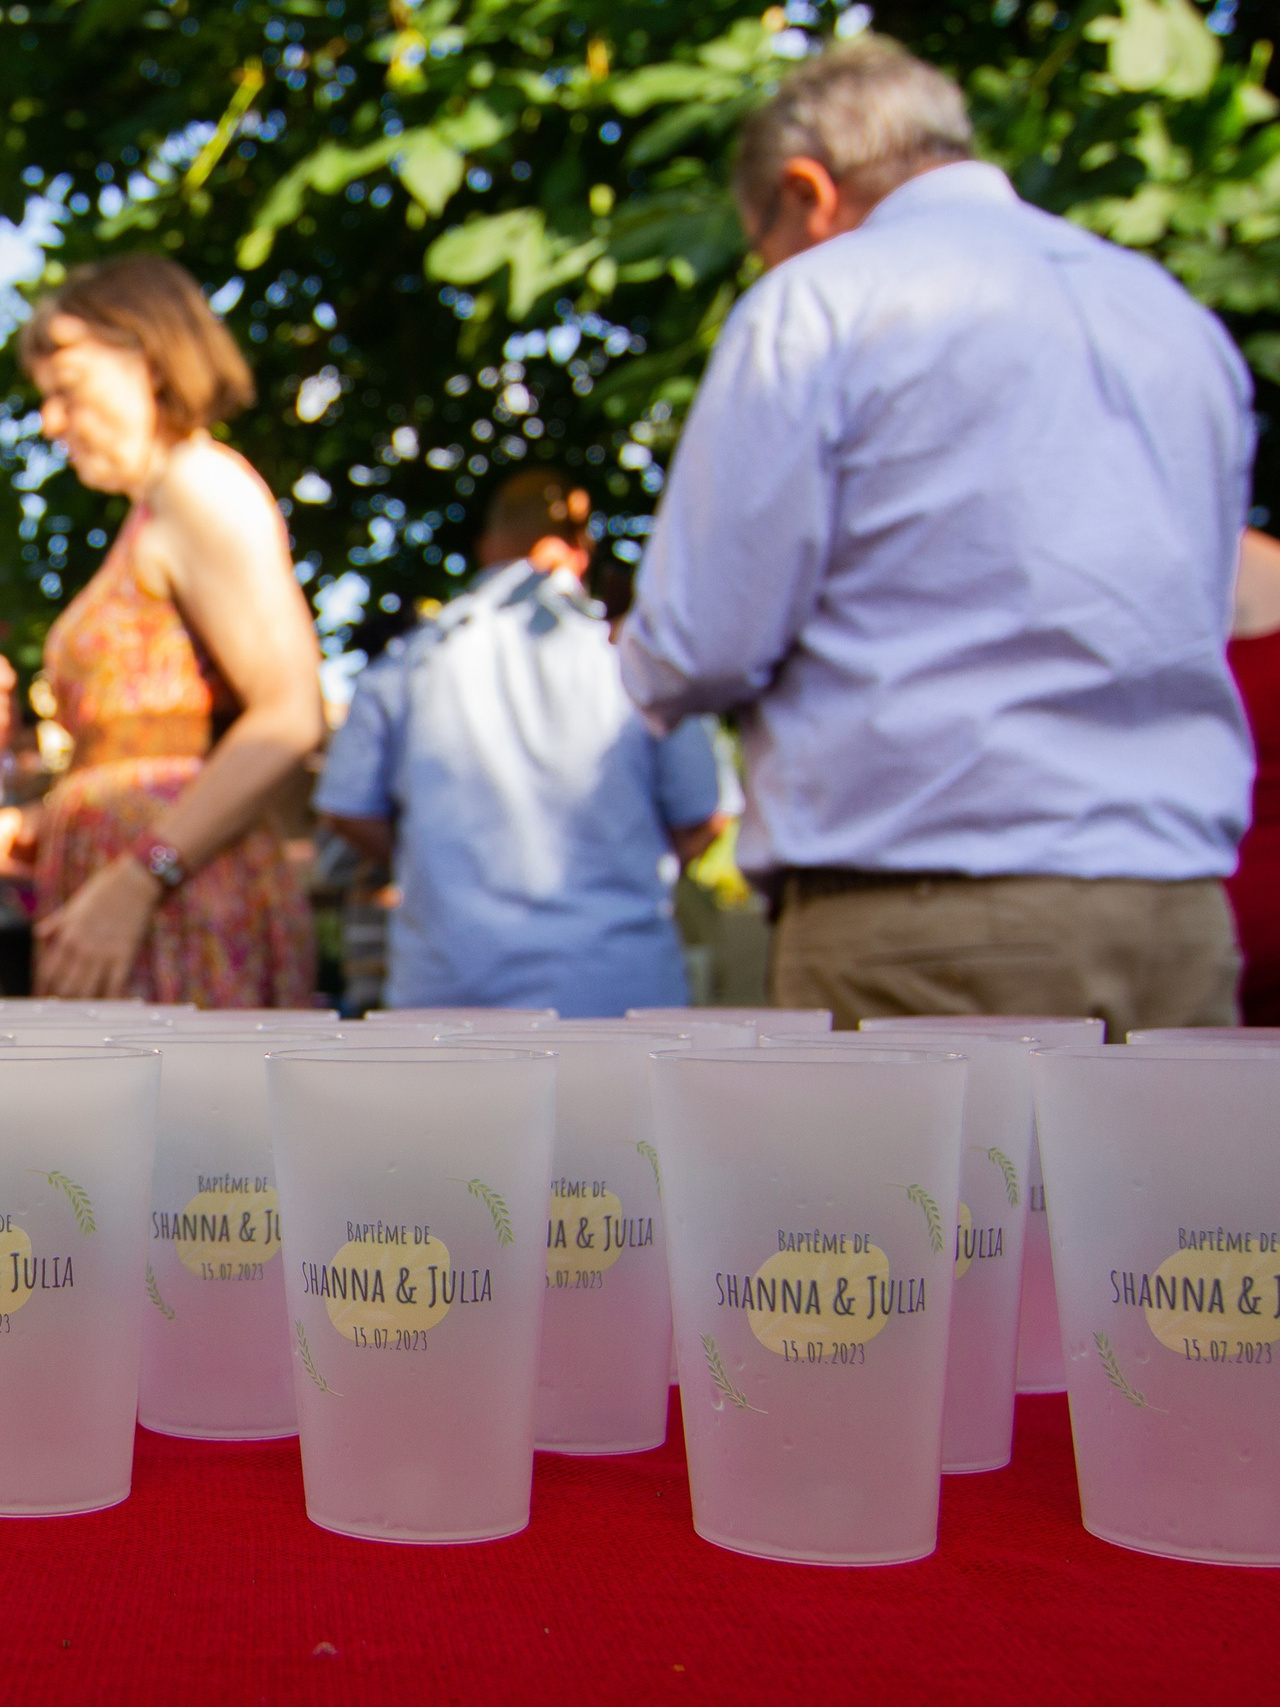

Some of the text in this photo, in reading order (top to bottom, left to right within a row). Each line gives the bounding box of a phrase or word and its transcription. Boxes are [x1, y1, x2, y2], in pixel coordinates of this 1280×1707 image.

[198, 1173, 268, 1194] BAPTÊME DE
[551, 1177, 606, 1198] TÊME DE
[152, 1211, 230, 1243] SHANNA
[239, 1211, 256, 1243] &
[346, 1219, 430, 1246] BAPTÊME DE
[576, 1216, 594, 1249] &
[603, 1215, 653, 1251] JULIA
[777, 1227, 870, 1254] BAPTÊME DE
[1178, 1226, 1277, 1253] BAPTÊME DE
[955, 1224, 1003, 1261] JULIA
[10, 1252, 74, 1293] JULIA
[201, 1262, 264, 1282] 15.07.2023
[301, 1261, 492, 1308] SHANNA & JULIA
[715, 1272, 926, 1319] SHANNA & JULIA
[1110, 1269, 1225, 1314] SHANNA
[1238, 1276, 1262, 1315] &
[353, 1326, 428, 1351] 15.07.2023
[1183, 1338, 1272, 1364] 15.07.2023
[782, 1340, 865, 1365] 15.07.2023
